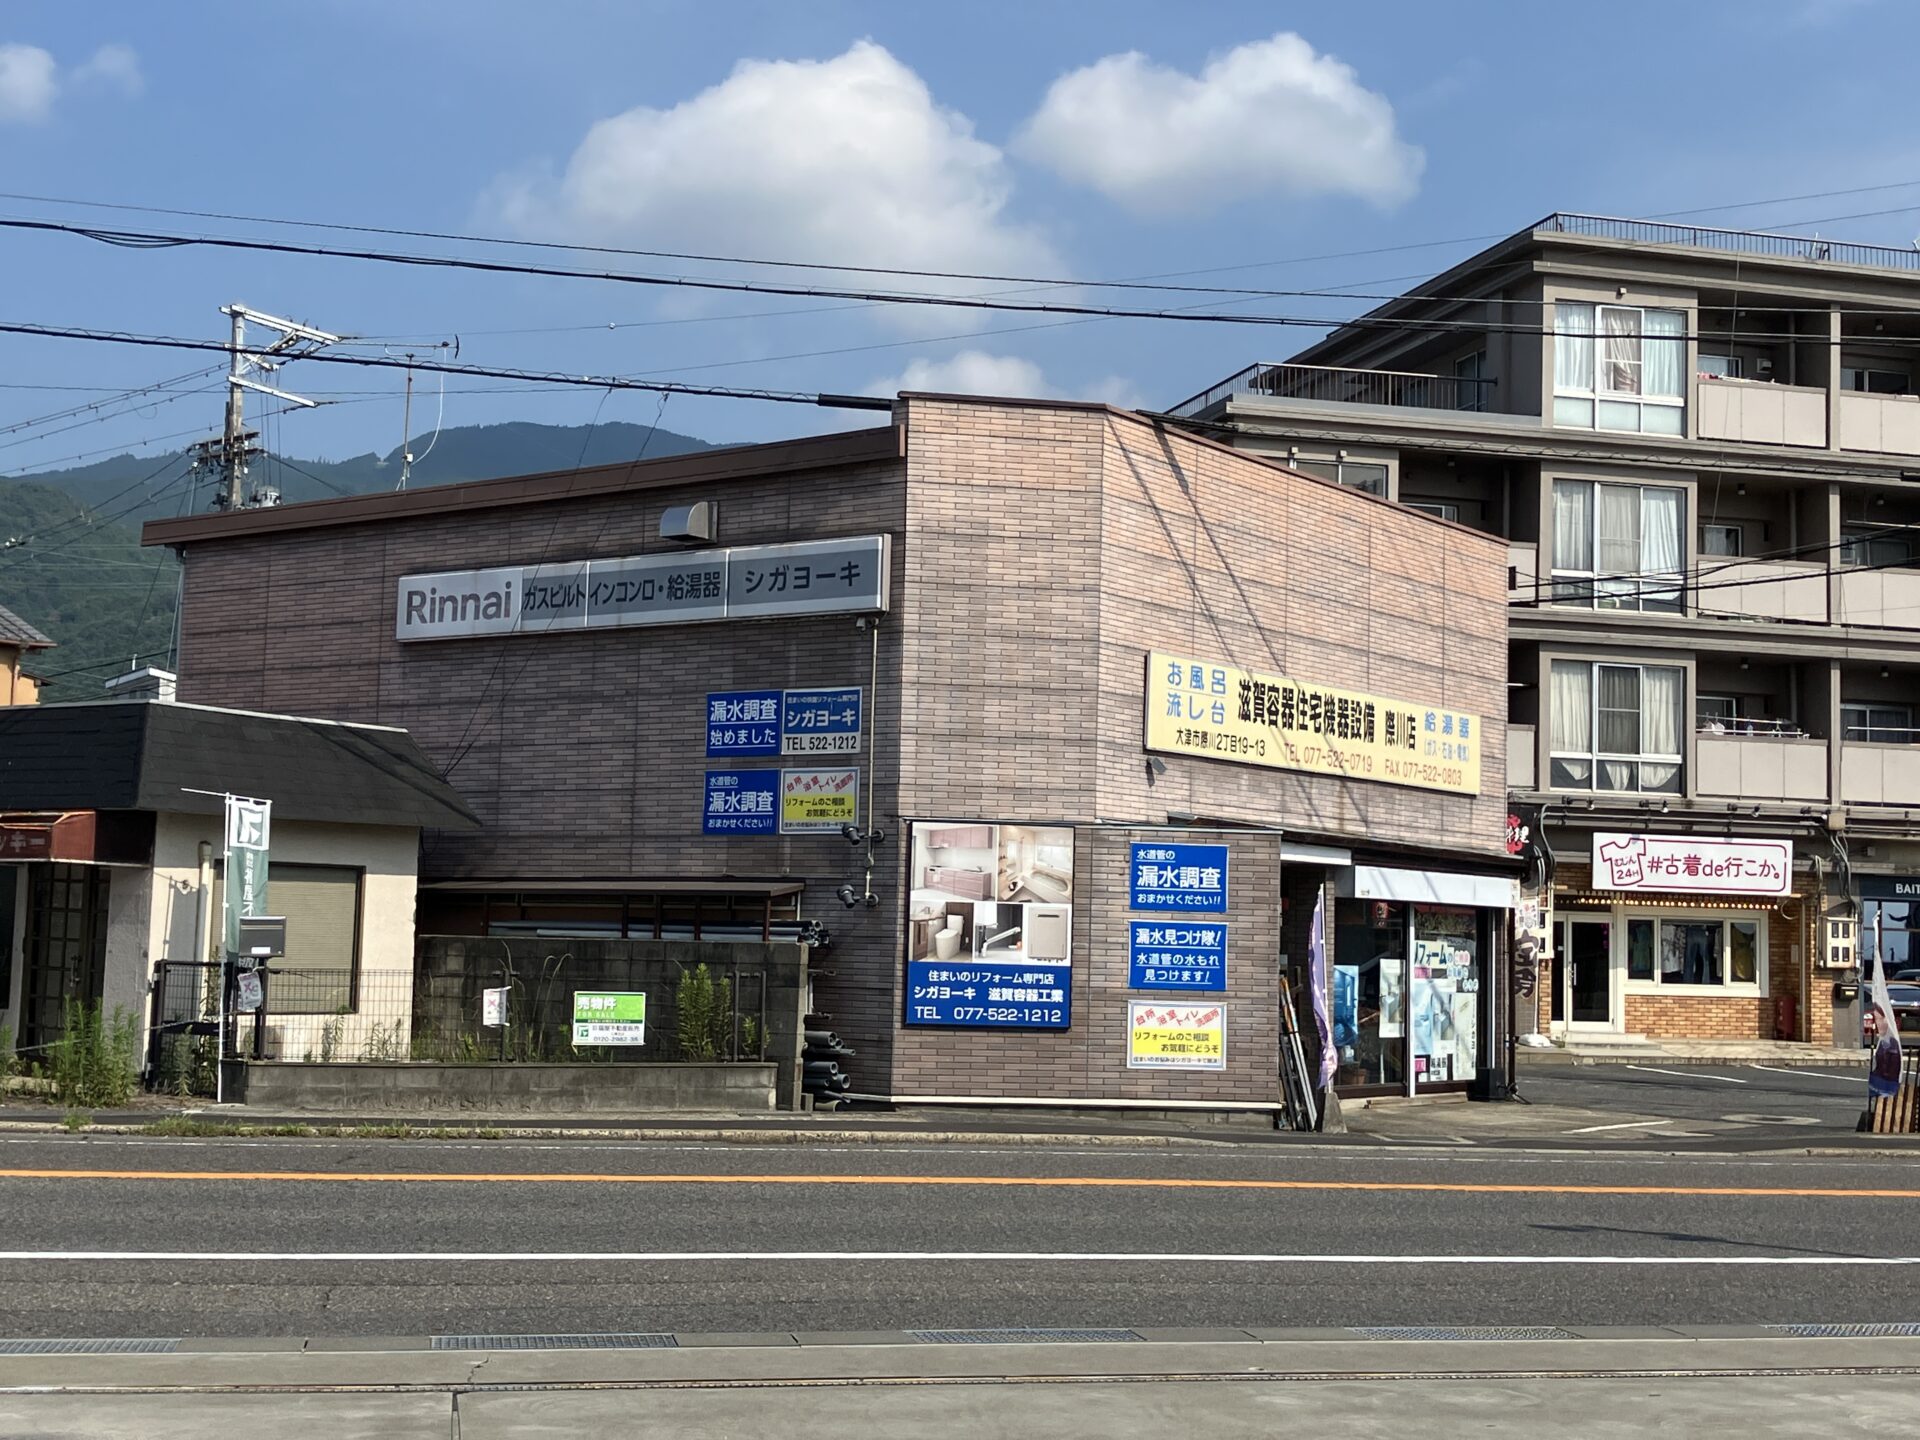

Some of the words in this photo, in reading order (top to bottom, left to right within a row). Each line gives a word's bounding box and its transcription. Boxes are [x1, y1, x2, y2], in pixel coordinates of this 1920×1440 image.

[745, 561, 860, 594] シガヨーキ
[524, 571, 720, 611] ガスビルトインコンロ・給湯器
[406, 581, 512, 625] Rinnai
[1167, 661, 1226, 695] お風呂
[710, 698, 777, 722] 漏水調査
[1167, 692, 1225, 725] 流し台
[1238, 678, 1375, 743] 滋賀容器住宅機器設備
[787, 708, 856, 728] シガヨーキ
[1424, 711, 1469, 739] 給湯器
[710, 728, 776, 746] 始めました
[786, 737, 806, 750] TEL
[809, 736, 856, 751] 522-1212
[1284, 742, 1300, 762] TEL
[1303, 746, 1372, 773] 077-522-0719
[1385, 758, 1400, 776] FAX
[709, 775, 738, 786] 水道管の
[709, 791, 773, 812] 漏水調査
[785, 797, 845, 807] リフォームのご相談
[806, 808, 853, 817] お気軽にどうぞ
[708, 818, 773, 828] おまかせください!!
[1137, 849, 1175, 860] 水道管の
[1614, 855, 1637, 867] むじん
[1616, 868, 1640, 881] 24H
[1647, 853, 1780, 880] #古着de行こか。
[1136, 865, 1221, 889] 漏水調査
[1137, 893, 1221, 905] おまかせください!!
[1136, 928, 1221, 946] 漏水見つけ隊!
[1136, 953, 1219, 966] 水道管の水もれ
[928, 969, 1055, 985] 住まいのリフォーム専門店
[1144, 968, 1210, 982] 見つけます!
[577, 995, 617, 1010] 売物件
[914, 986, 977, 999] シガヨーキ
[988, 987, 1063, 1002] 滋賀容器工業
[914, 1006, 941, 1019] TEL
[953, 1007, 1061, 1022] 077-522-1212
[1134, 1031, 1210, 1042] リフォームのご相談
